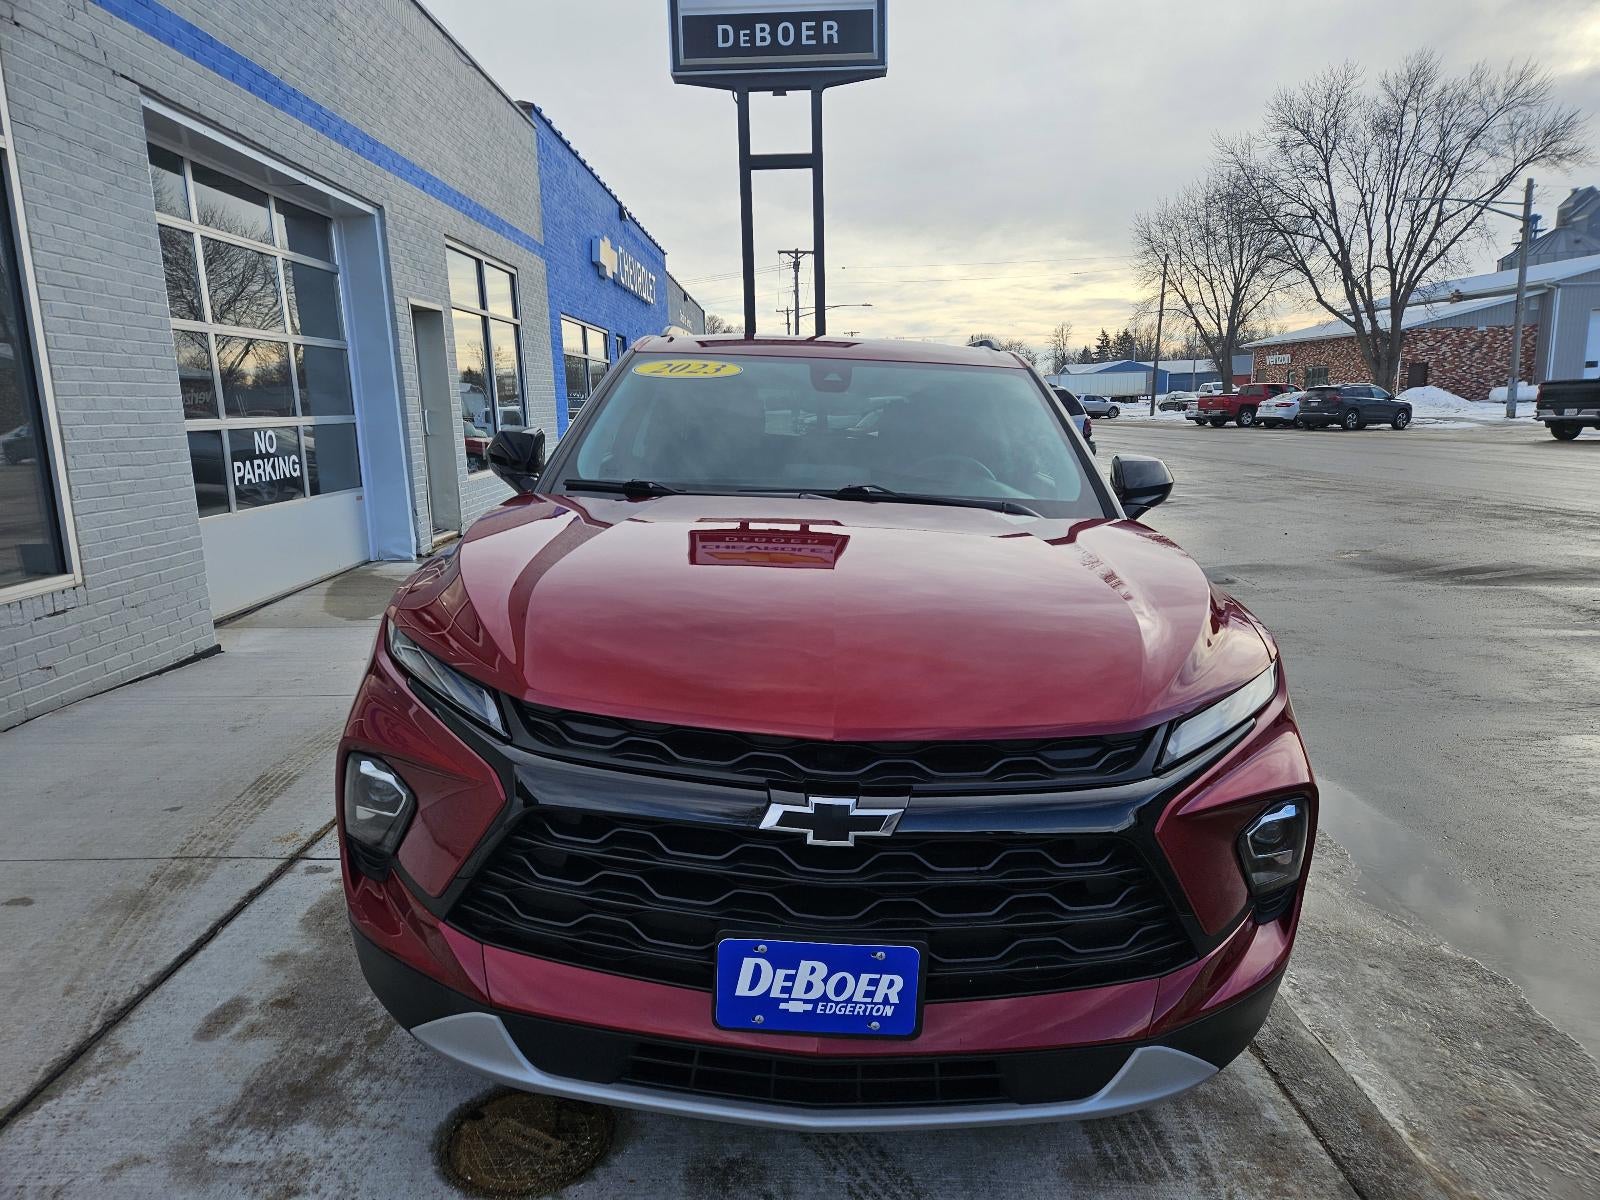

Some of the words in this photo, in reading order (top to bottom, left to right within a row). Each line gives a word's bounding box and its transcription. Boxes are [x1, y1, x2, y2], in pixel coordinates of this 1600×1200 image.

[618, 245, 656, 305] CHEVROLET
[649, 363, 727, 374] 2023
[1265, 352, 1291, 365] verizon
[253, 429, 277, 455] NO
[233, 454, 301, 486] PARKING
[816, 1002, 895, 1017] EDGERTON
